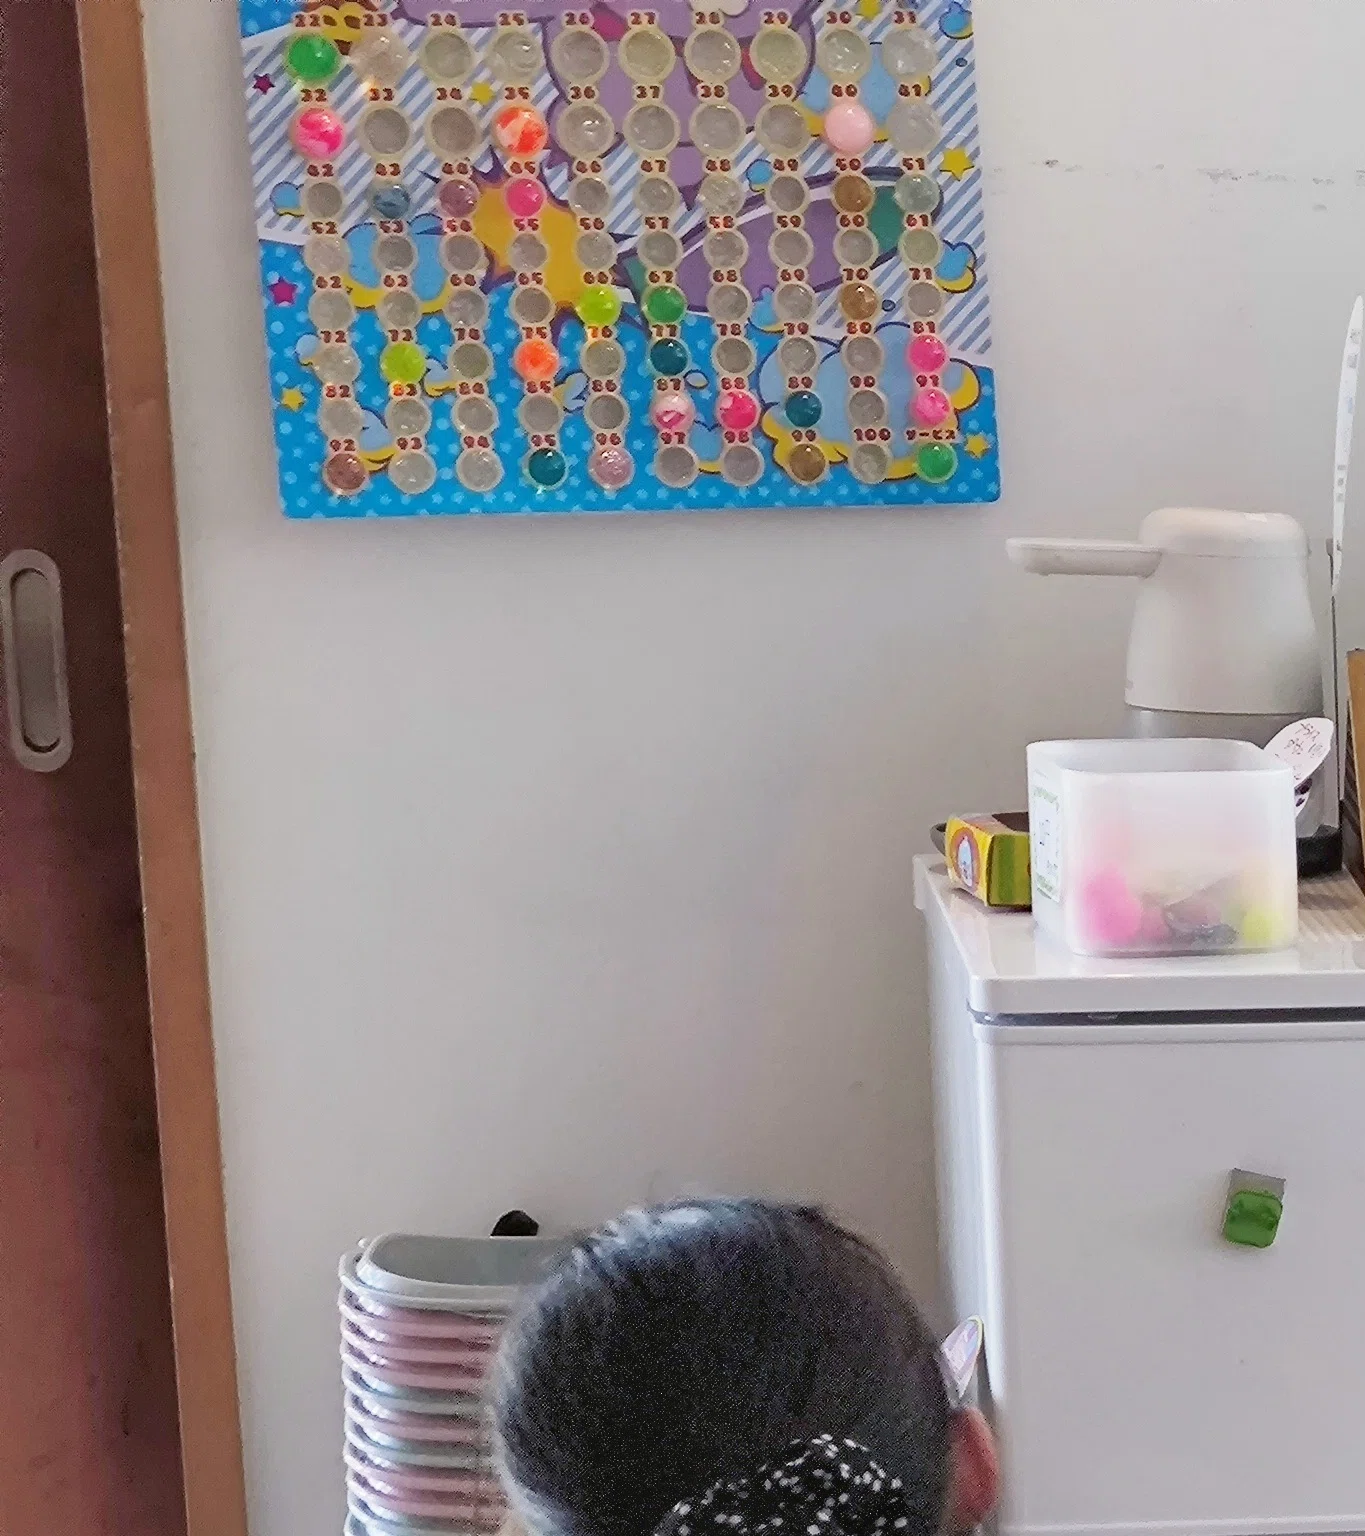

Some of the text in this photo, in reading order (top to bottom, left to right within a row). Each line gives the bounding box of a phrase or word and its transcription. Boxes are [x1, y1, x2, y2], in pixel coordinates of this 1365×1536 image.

[296, 11, 320, 27] 22
[359, 11, 387, 27] 23
[500, 13, 524, 25] 25
[566, 10, 593, 28] 26
[627, 12, 655, 25] 27
[696, 13, 719, 24] 28
[764, 12, 788, 24] 29
[828, 12, 851, 24] 30
[895, 12, 915, 23] 31
[303, 89, 327, 102] 32
[370, 88, 393, 101] 33
[505, 87, 529, 100] 35
[571, 87, 594, 99] 36
[638, 86, 659, 98] 37
[697, 81, 724, 98] 38
[764, 85, 792, 97] 39
[834, 158, 864, 173] 50
[903, 158, 924, 170] 51
[312, 222, 336, 234] 52
[380, 222, 403, 233] 53
[514, 219, 538, 231] 55
[580, 218, 604, 230] 56
[645, 217, 668, 229] 57
[709, 216, 733, 228] 58
[777, 216, 801, 228] 59
[836, 212, 864, 227] 60
[906, 215, 928, 226] 61
[317, 276, 341, 288] 62
[384, 275, 408, 287] 63
[518, 273, 542, 285] 65
[584, 271, 614, 284] 66
[651, 271, 673, 283] 67
[713, 270, 736, 282] 68
[777, 269, 808, 282] 69
[839, 268, 868, 284] 70
[911, 268, 932, 280] 71
[324, 331, 346, 343] 72
[391, 330, 411, 341] 73
[524, 327, 551, 339] 75
[589, 327, 611, 338] 76
[656, 327, 675, 336] 77
[718, 324, 741, 336] 78
[781, 323, 808, 335] 79
[847, 319, 871, 337] 80
[913, 321, 935, 333] 81
[326, 385, 350, 398] 82
[394, 385, 417, 396] 83
[523, 381, 555, 393] 85
[592, 380, 616, 392] 86
[658, 380, 681, 391] 87
[721, 378, 745, 390] 88
[789, 377, 812, 389] 89
[852, 376, 875, 391] 90
[916, 375, 939, 387] 91
[331, 439, 355, 451] 92
[398, 437, 421, 449] 93
[532, 435, 555, 446] 95
[597, 433, 620, 445] 96
[661, 432, 685, 444] 97
[722, 428, 752, 443] 98
[792, 433, 816, 445] 99
[856, 429, 889, 441] 100
